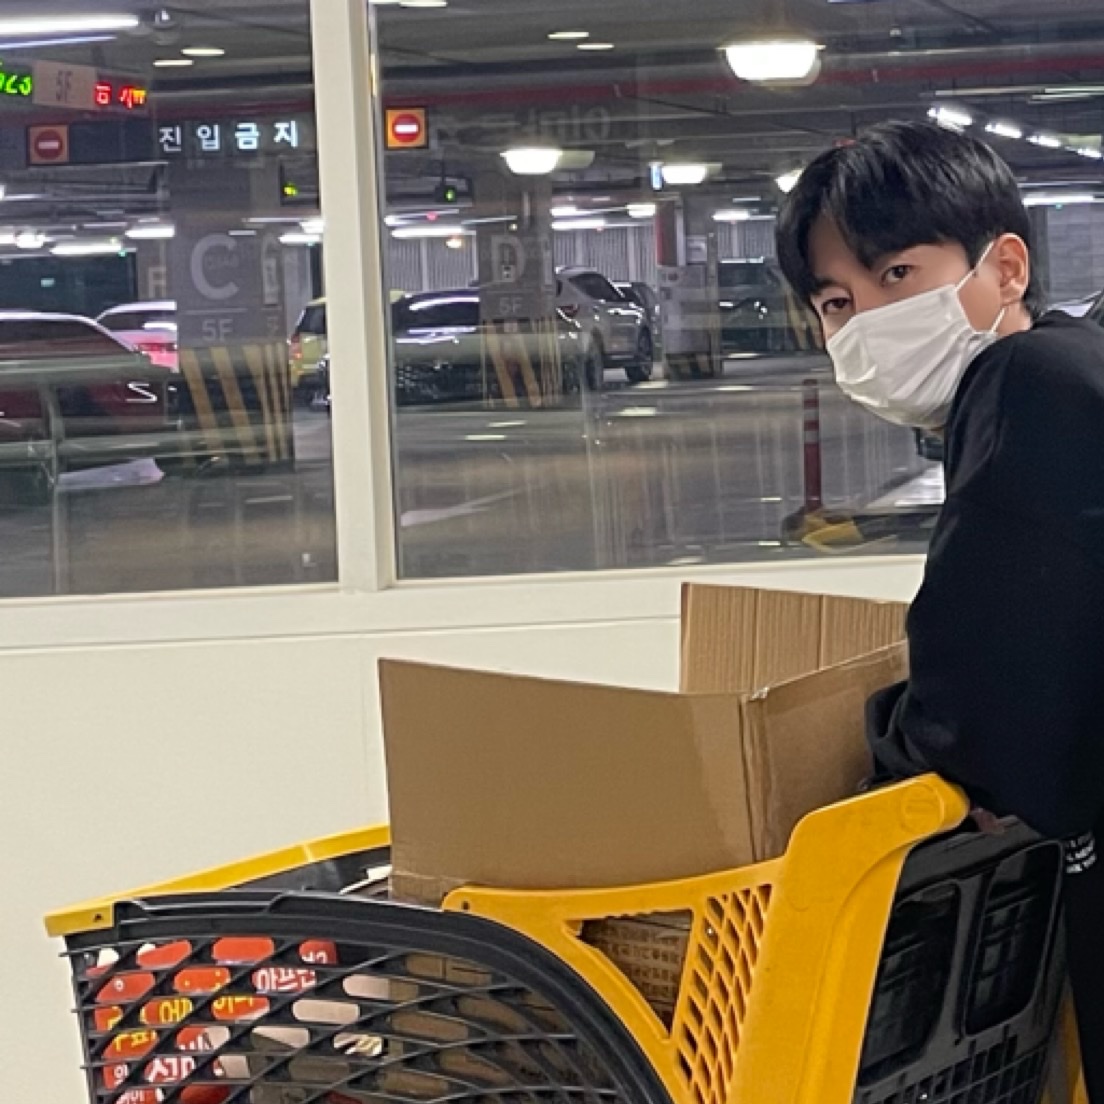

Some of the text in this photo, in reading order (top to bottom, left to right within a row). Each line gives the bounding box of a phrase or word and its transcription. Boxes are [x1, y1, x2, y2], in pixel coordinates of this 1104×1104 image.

[158, 120, 299, 152] 진입금지
[190, 233, 240, 300] C
[202, 318, 234, 343] 5F
